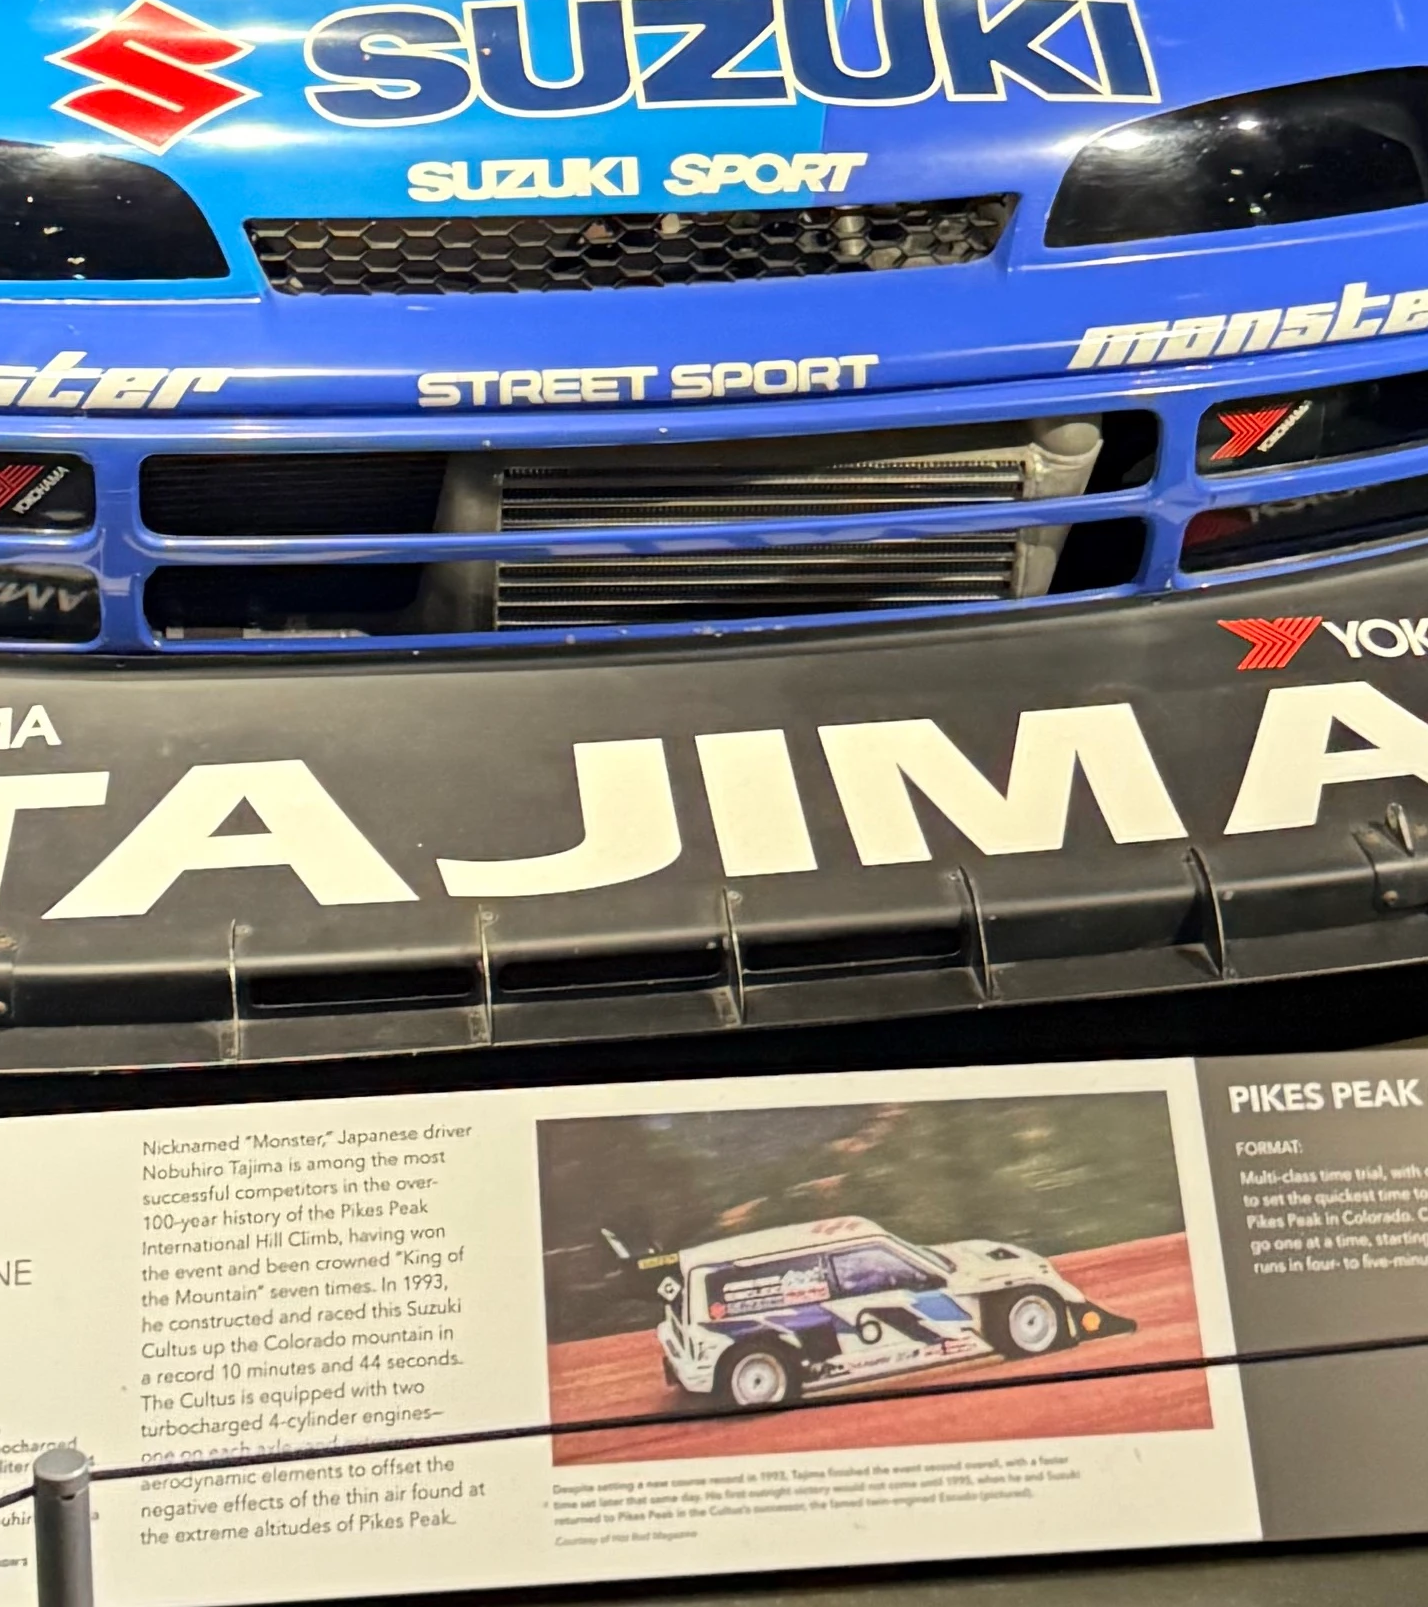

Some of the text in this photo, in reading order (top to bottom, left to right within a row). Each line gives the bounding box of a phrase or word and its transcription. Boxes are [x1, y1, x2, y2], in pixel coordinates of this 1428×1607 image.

[408, 153, 868, 202] SUZUKI SPORT
[412, 354, 879, 406] STREET SPORT
[11, 465, 71, 514] YOKOHAMA
[1228, 1082, 1325, 1114] PIKES
[1331, 1078, 1424, 1110] PEAK
[143, 1134, 240, 1156] Nicknamed
[337, 1129, 418, 1147] Japanese
[423, 1123, 473, 1140] driver
[142, 1151, 446, 1181] Nobuhiro Tajima is among the most
[142, 1176, 438, 1206] successful competitors in the over-
[143, 1198, 428, 1234] 100-year history of the Pikes Peak
[142, 1227, 446, 1256] International Hill Climb, having won
[142, 1265, 170, 1282] the
[175, 1264, 223, 1280] event
[227, 1257, 261, 1277] and
[266, 1257, 310, 1274] been
[315, 1251, 390, 1271] crowned
[447, 1245, 464, 1263] of
[141, 1290, 170, 1308] the
[270, 1285, 319, 1300] seven
[324, 1282, 377, 1296] times.
[381, 1276, 397, 1293] In
[404, 1273, 448, 1292] 1993,
[142, 1296, 462, 1333] he constructed and raced this Suzuki
[141, 1324, 454, 1359] Cultus up the Colorado mountain in
[141, 1348, 464, 1386] a record 10 minutes and 44 seconds.
[140, 1379, 425, 1412] The Cultus is equipped with two
[141, 1413, 263, 1438] turbocharged
[268, 1408, 358, 1433] 4-cylinder
[139, 1470, 257, 1494] aerodynamic
[261, 1466, 343, 1483] elements
[348, 1464, 366, 1478] to
[371, 1458, 421, 1477] offset
[426, 1456, 455, 1473] the
[141, 1480, 485, 1522] negative effects of the thin air found at
[140, 1508, 457, 1546] the extreme altitudes of Pikes Peak.
